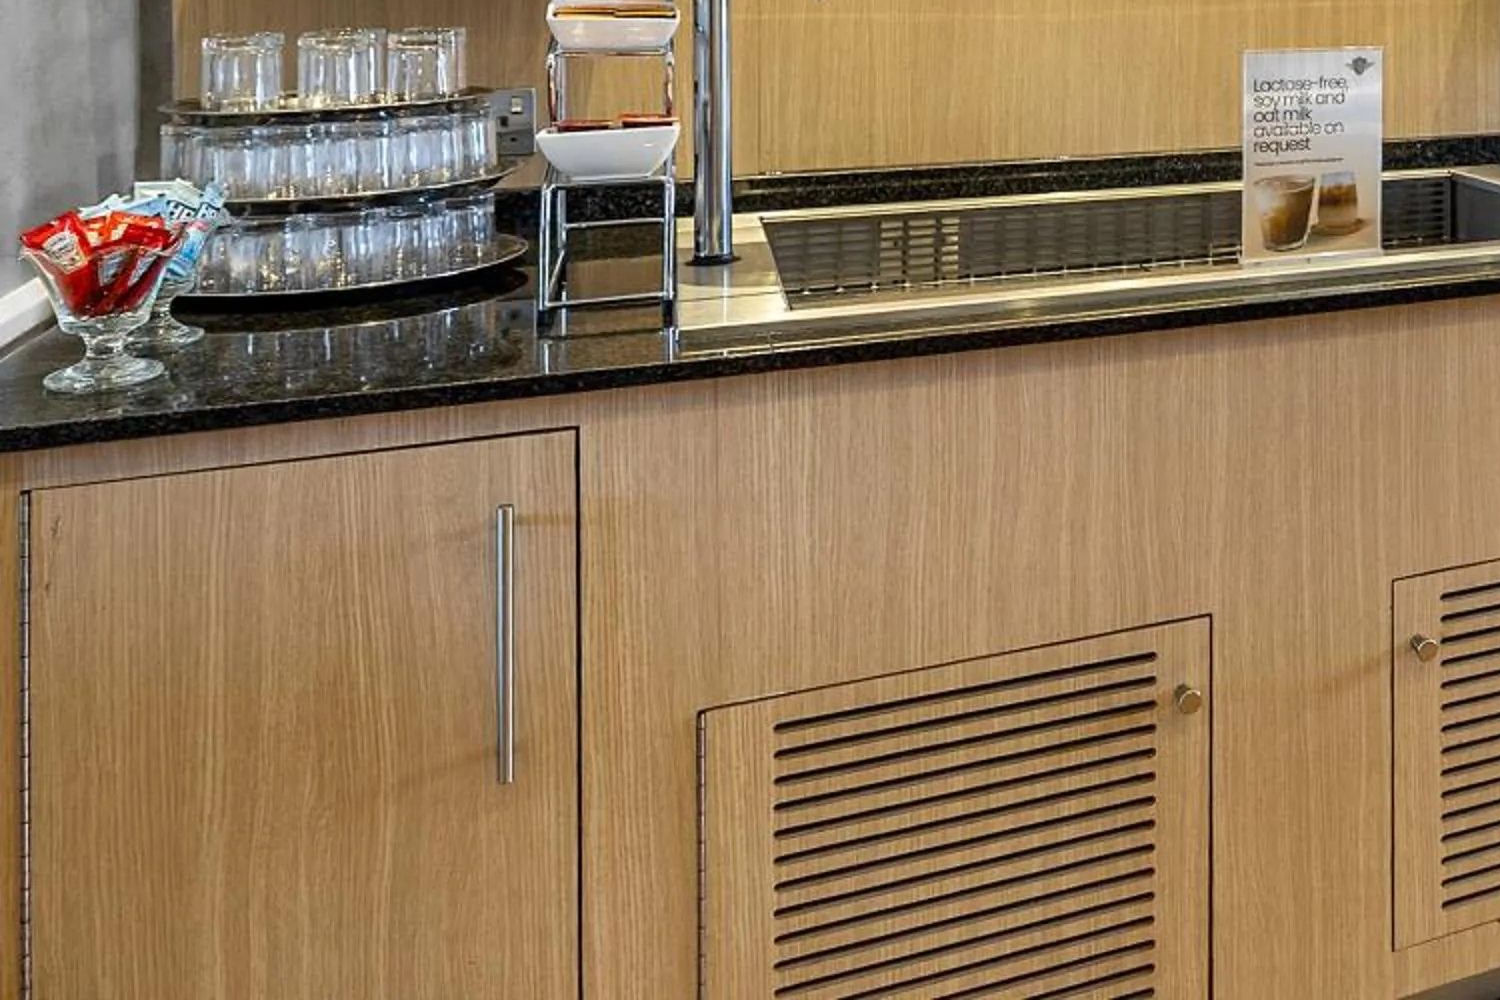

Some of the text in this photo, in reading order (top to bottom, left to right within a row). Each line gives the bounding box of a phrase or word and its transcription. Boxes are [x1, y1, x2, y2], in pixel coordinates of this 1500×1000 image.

[1253, 76, 1349, 93] Lactose-free,
[1253, 92, 1345, 109] soy milk and
[1253, 107, 1312, 123] oat milk
[1253, 120, 1344, 138] available on
[1253, 137, 1311, 156] request
